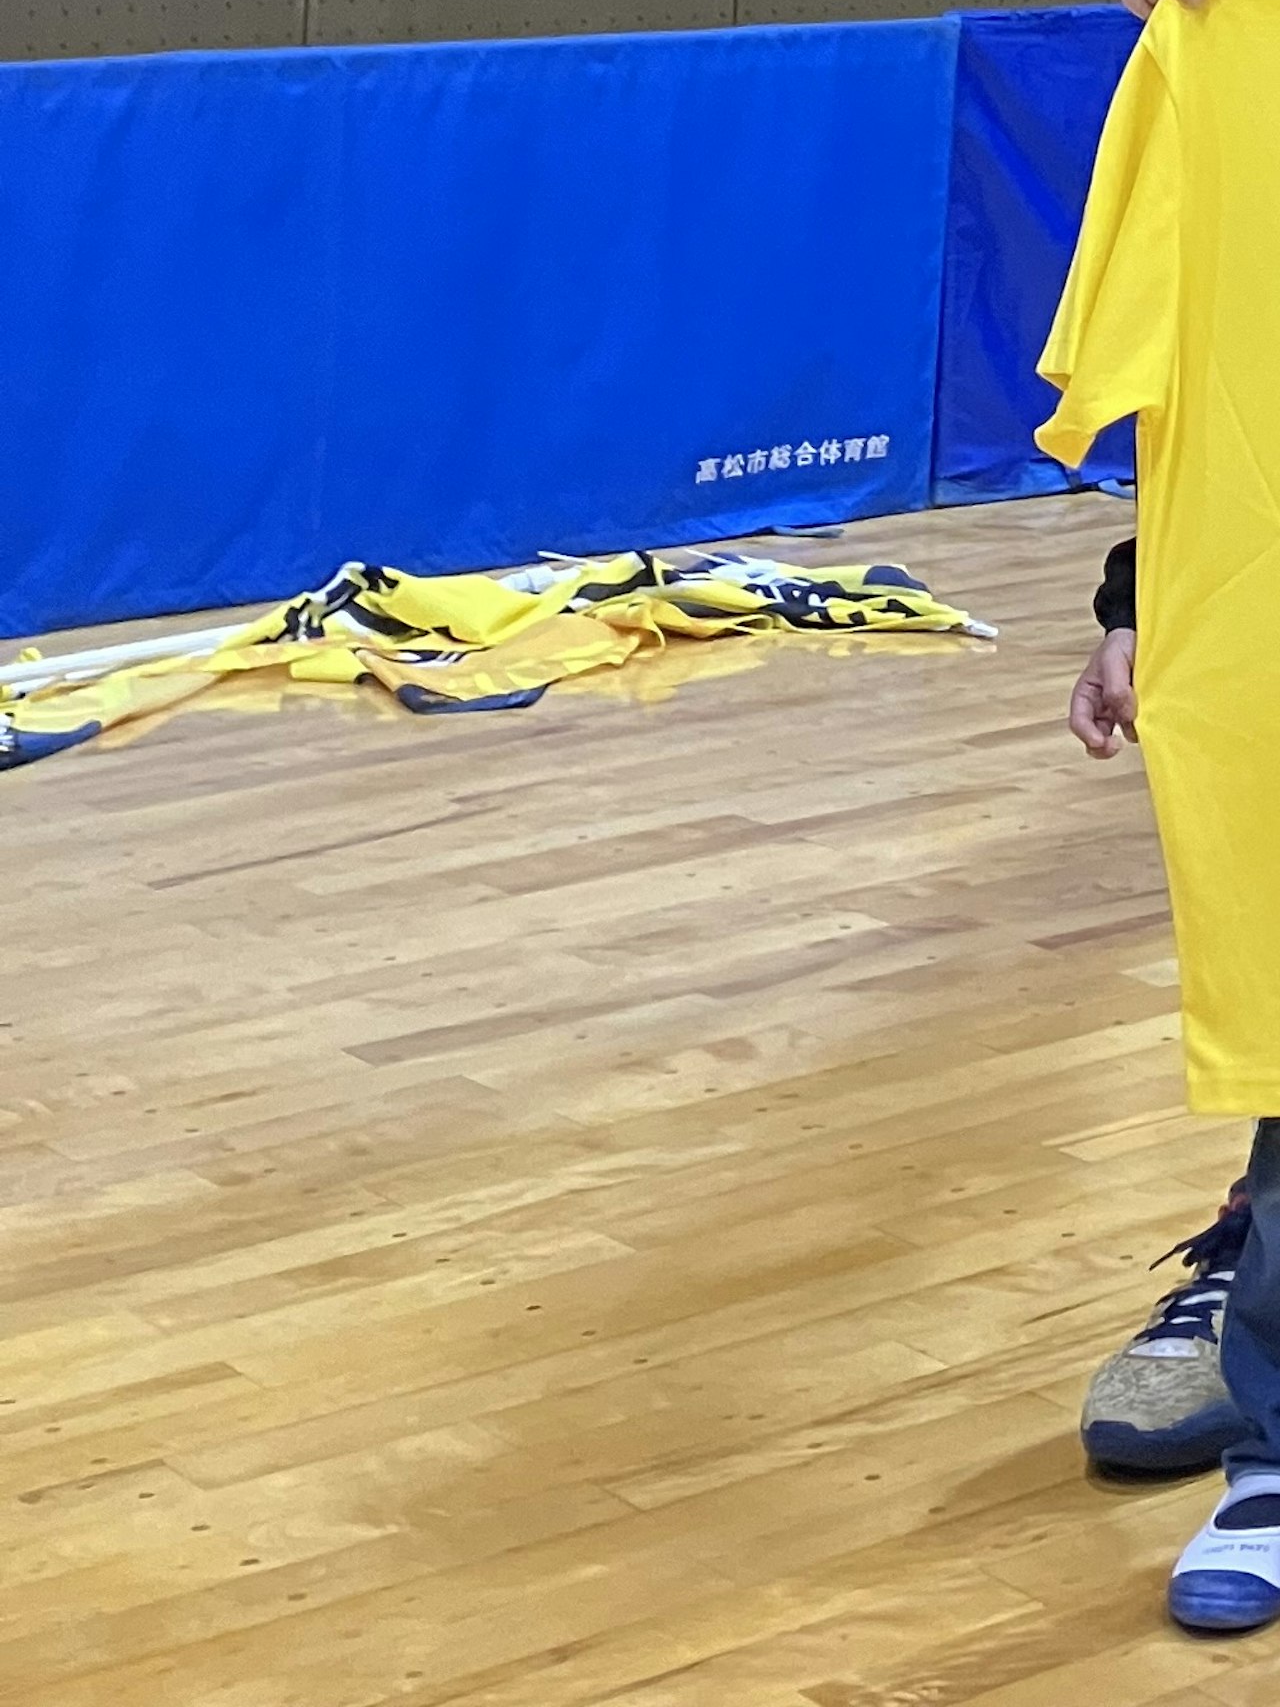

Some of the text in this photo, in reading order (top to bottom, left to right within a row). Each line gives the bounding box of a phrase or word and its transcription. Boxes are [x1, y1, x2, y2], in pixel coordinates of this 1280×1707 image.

[695, 433, 890, 484] 高松市総合体育館
